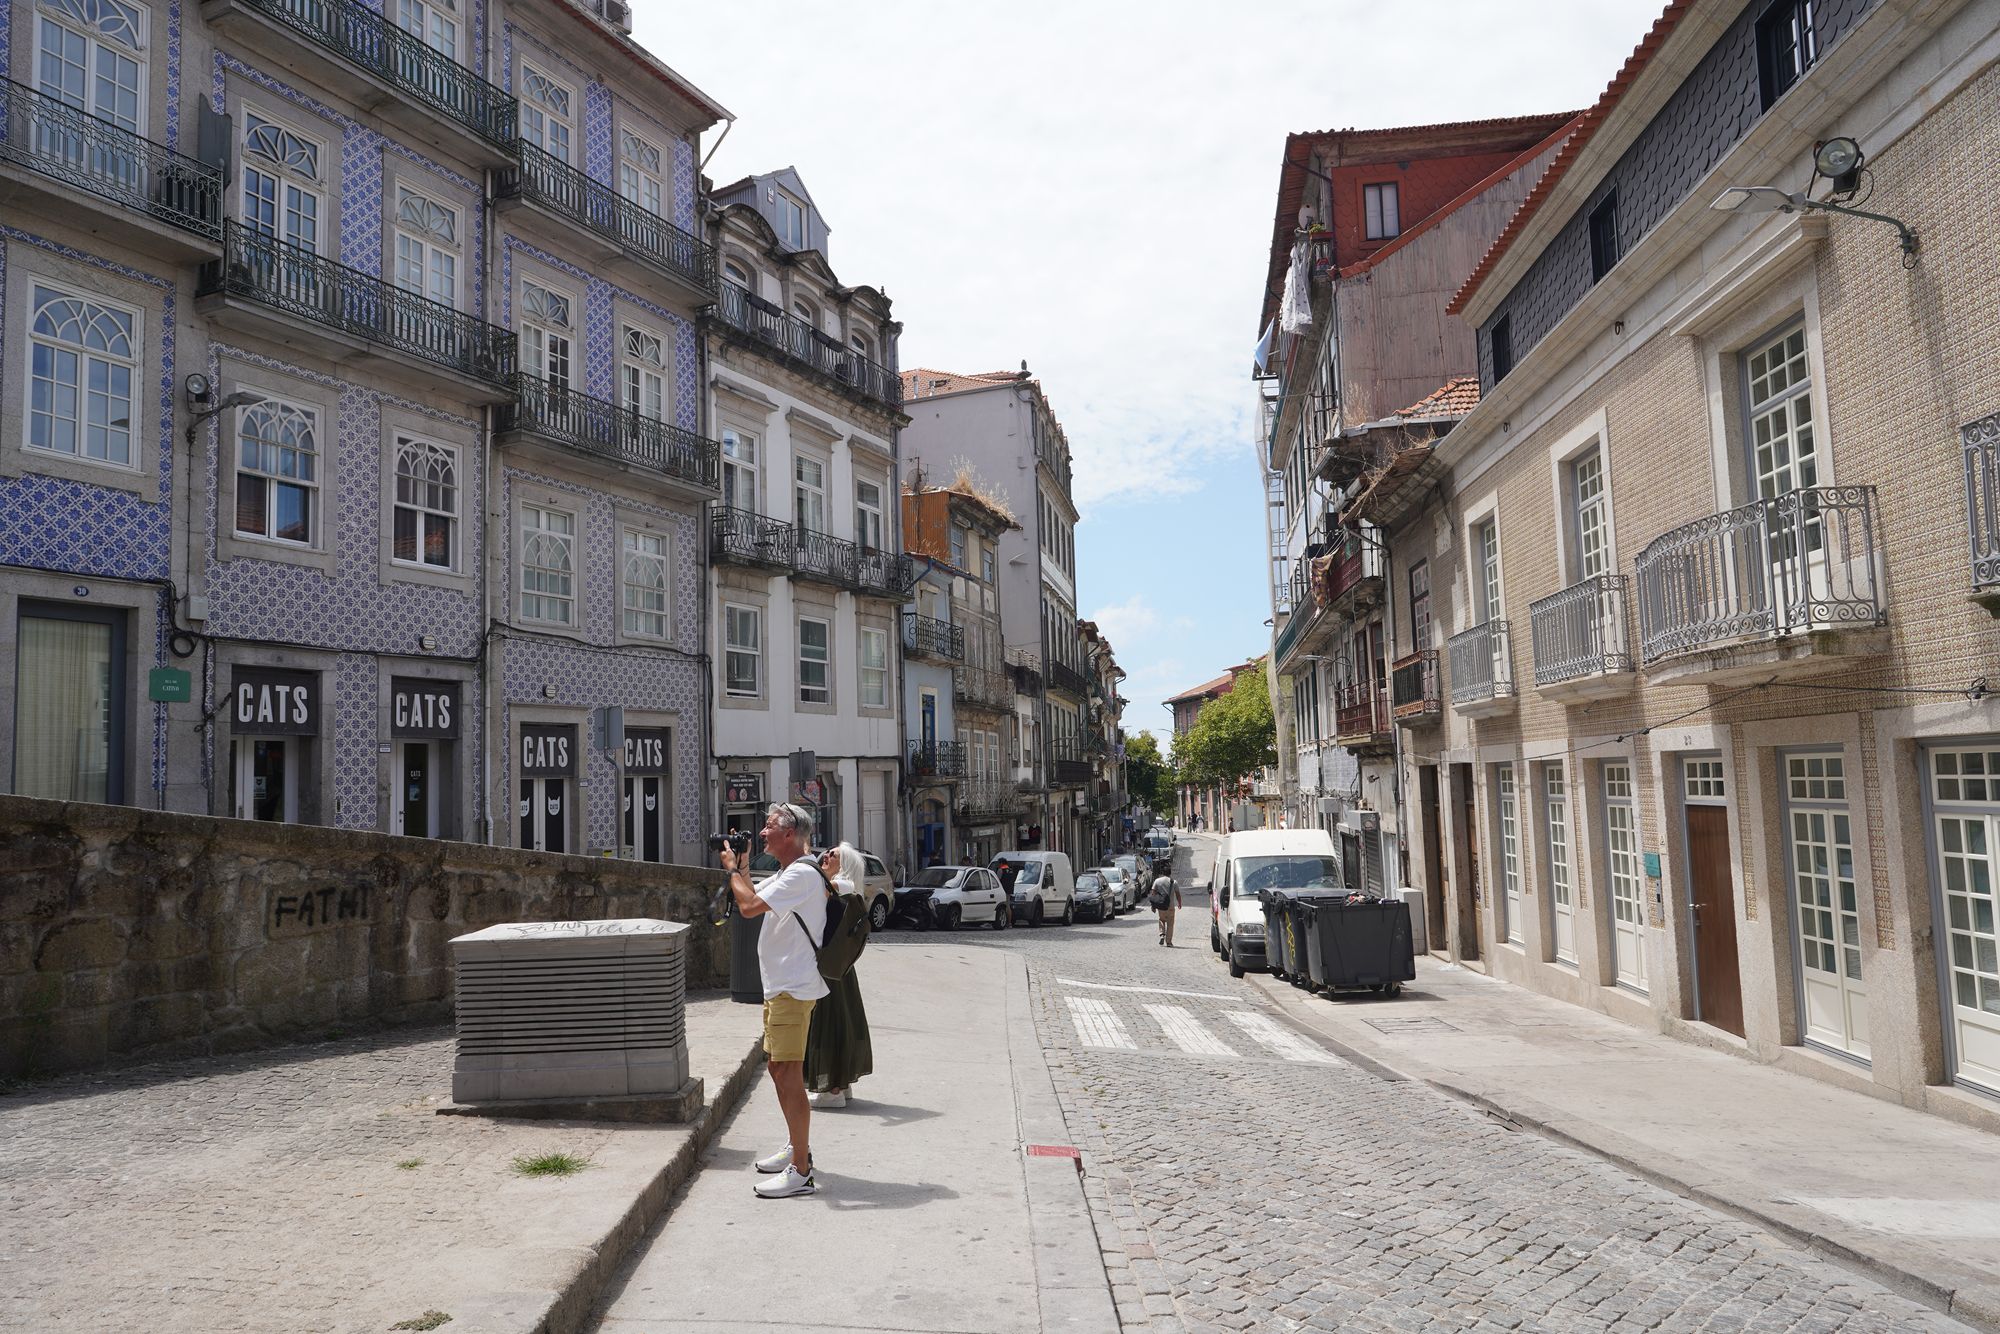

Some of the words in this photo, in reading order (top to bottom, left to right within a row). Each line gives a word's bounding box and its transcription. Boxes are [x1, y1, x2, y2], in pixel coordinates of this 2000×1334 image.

[238, 682, 308, 724] CATS
[395, 692, 450, 729] CATS
[523, 736, 569, 768] CATS
[624, 738, 663, 767] CATS
